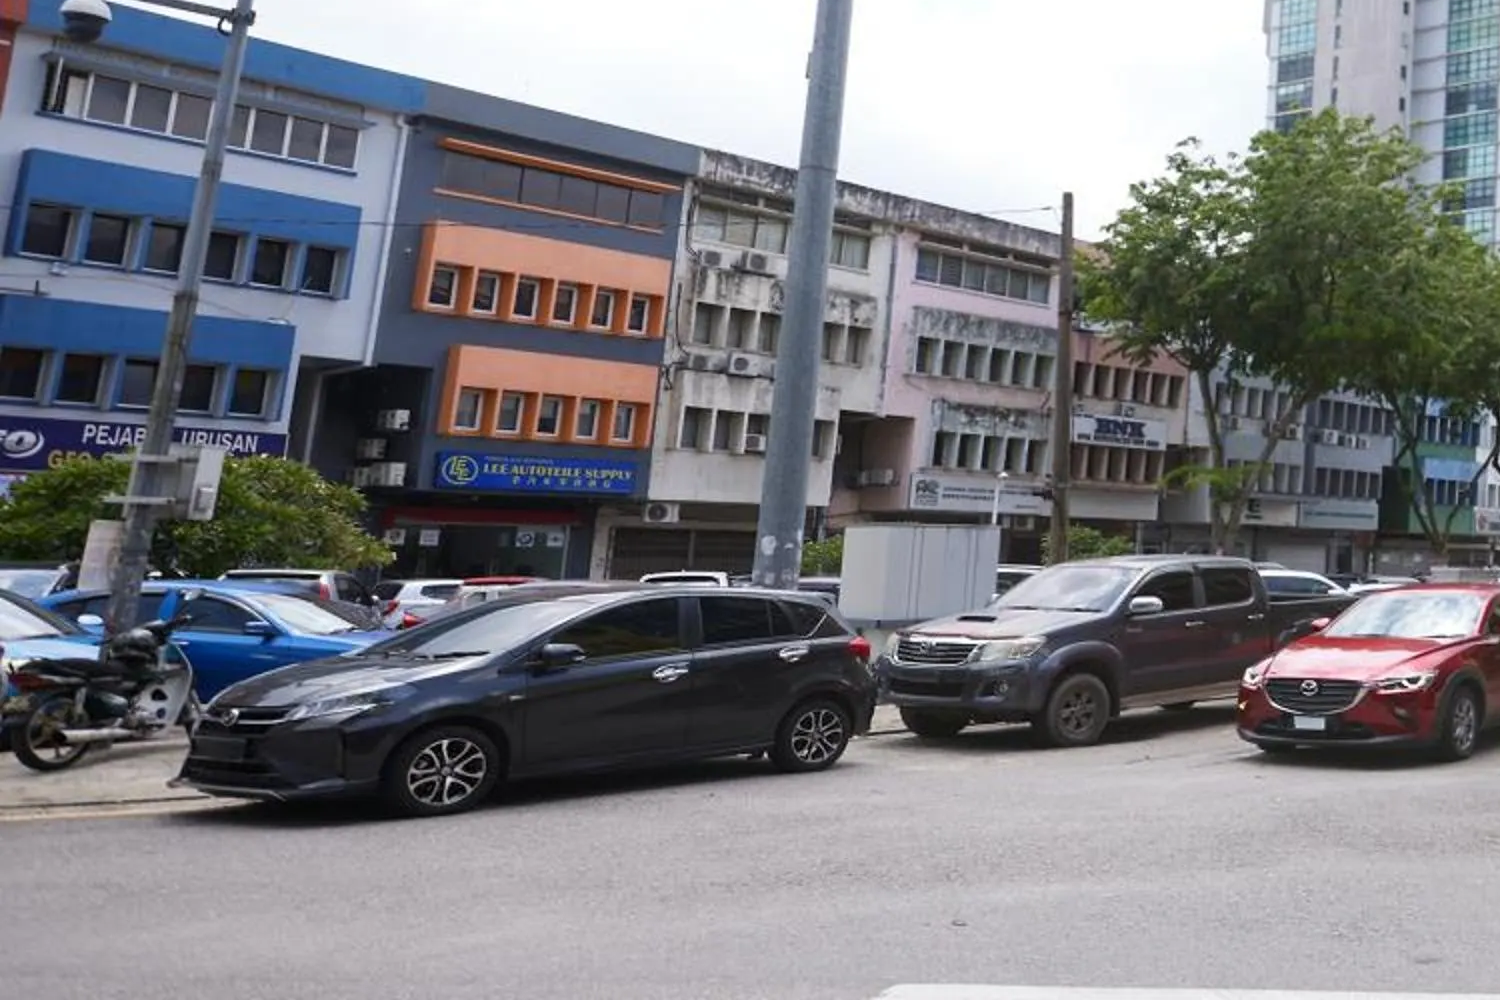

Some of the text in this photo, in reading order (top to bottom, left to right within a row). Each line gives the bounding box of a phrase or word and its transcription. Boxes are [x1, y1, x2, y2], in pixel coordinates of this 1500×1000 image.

[81, 423, 259, 453] PEJAB URUSAN
[483, 463, 510, 474] LEE
[586, 468, 633, 481] SUPPLY
